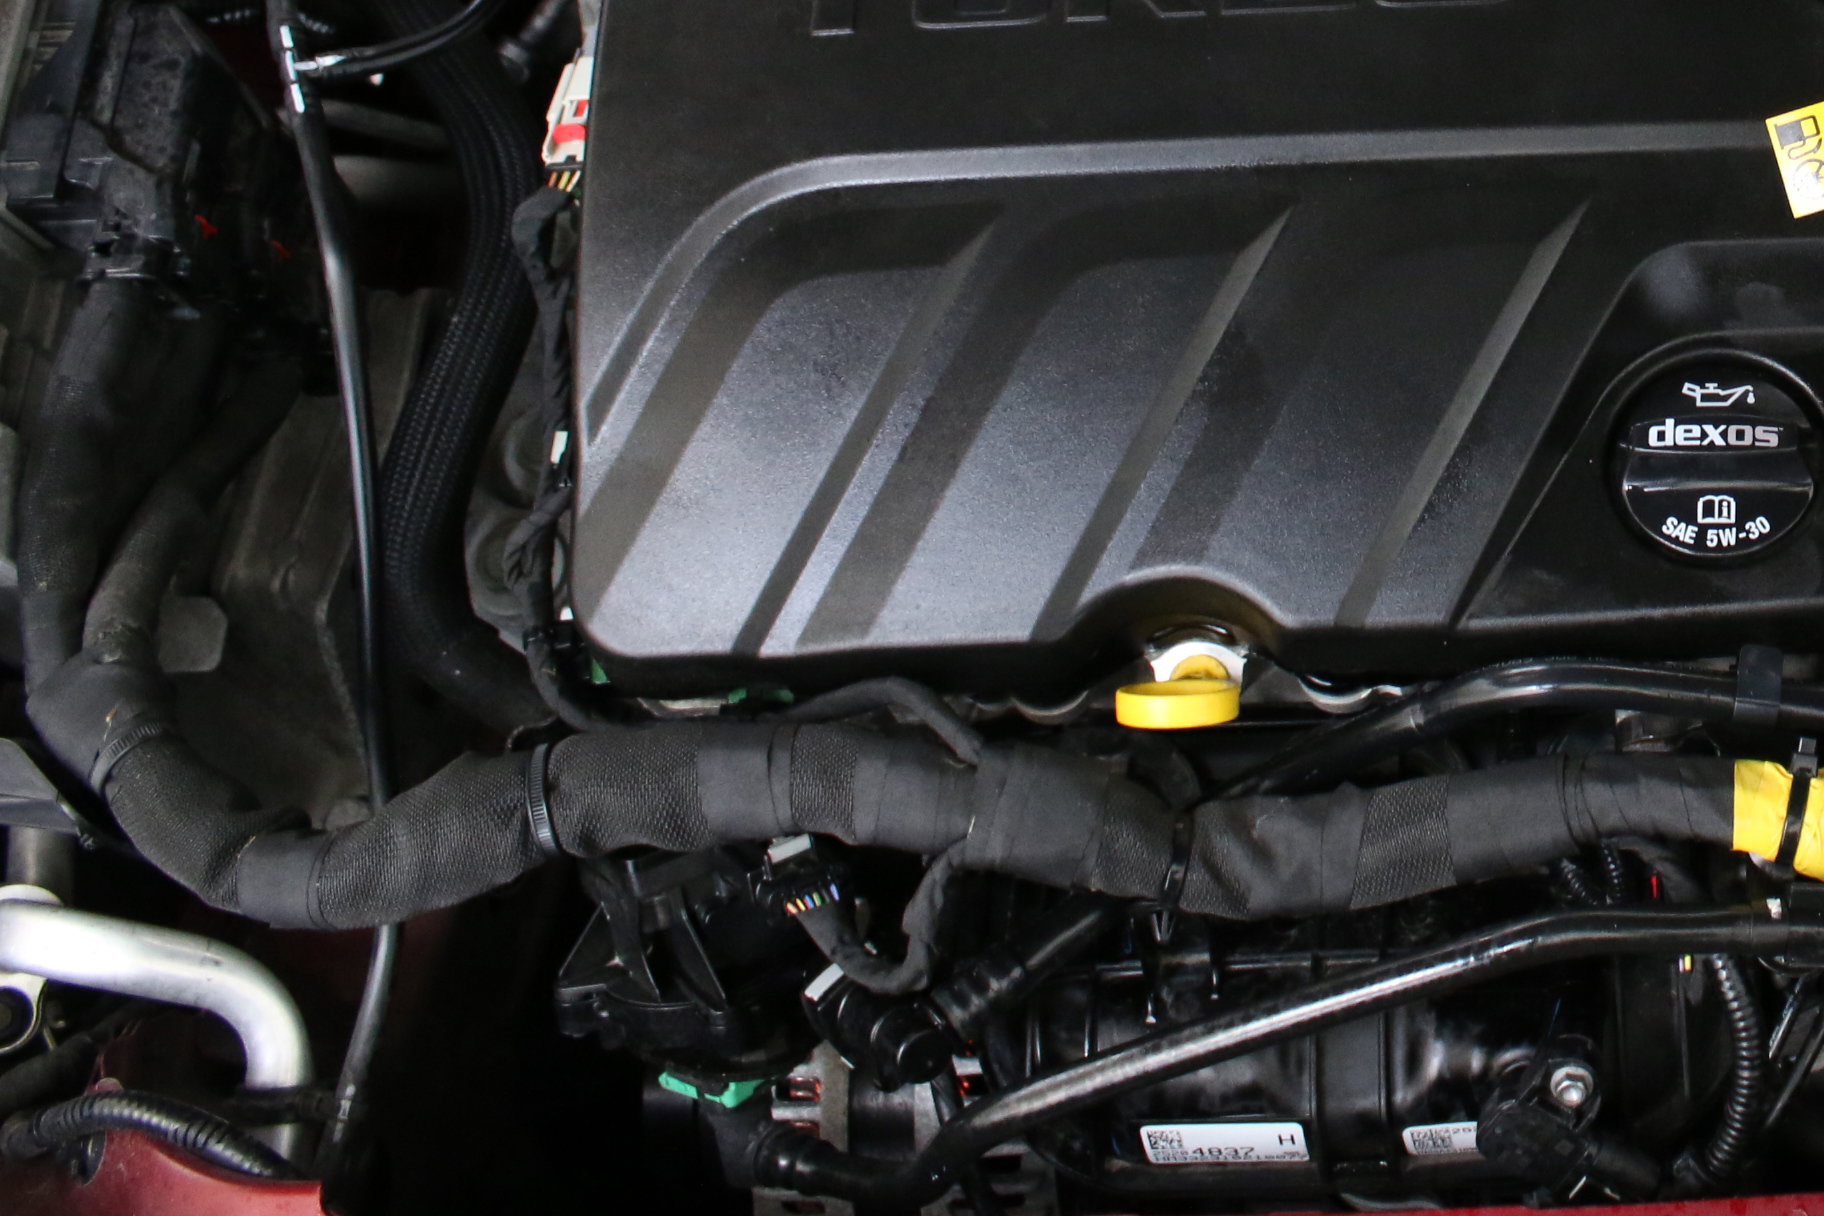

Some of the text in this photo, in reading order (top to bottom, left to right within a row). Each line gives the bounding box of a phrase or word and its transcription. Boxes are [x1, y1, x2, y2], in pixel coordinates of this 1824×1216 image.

[1648, 418, 1779, 448] dexos
[1661, 516, 1771, 547] SAE 5W-30
[1278, 1134, 1296, 1145] H
